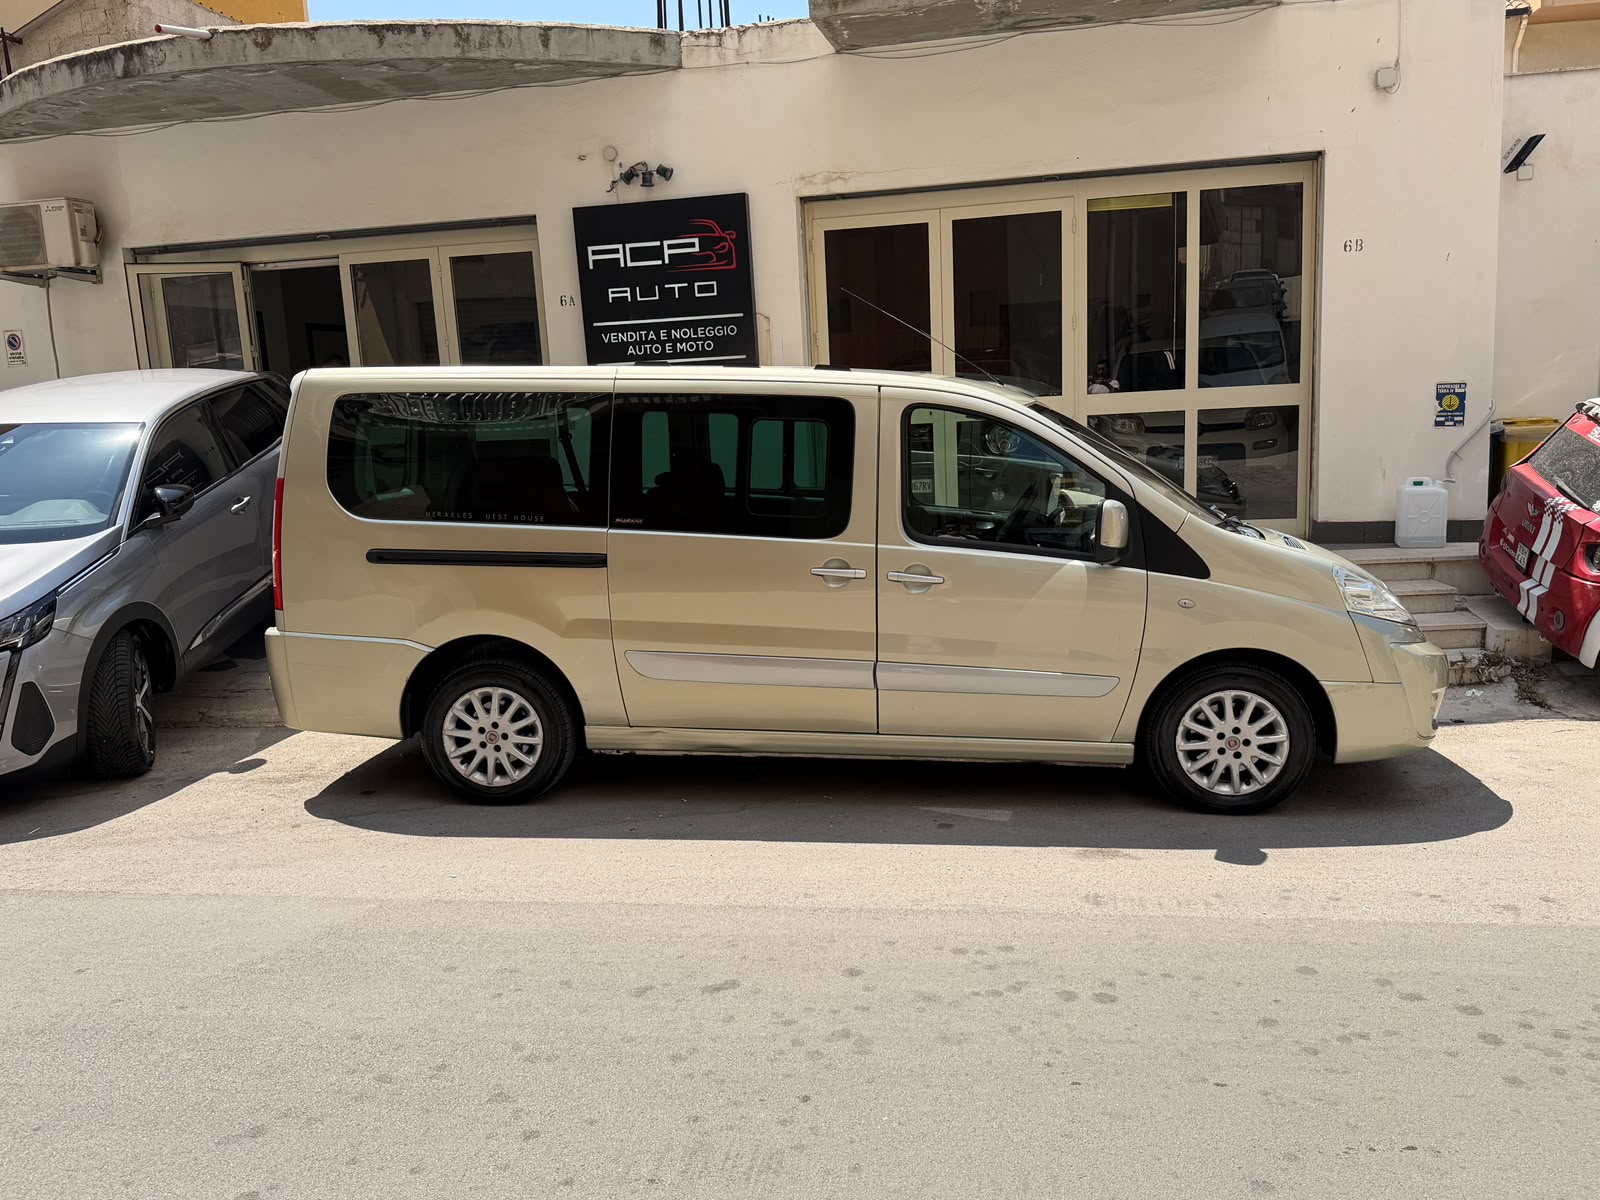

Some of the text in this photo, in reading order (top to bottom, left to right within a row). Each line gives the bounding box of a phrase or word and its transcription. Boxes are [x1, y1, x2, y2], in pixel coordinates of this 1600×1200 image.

[1343, 238, 1364, 252] 6B
[587, 238, 700, 270] ACP
[608, 281, 718, 303] AUTO
[559, 294, 576, 307] 6A
[601, 325, 737, 344] VENDITA E NOLEGGIO
[627, 340, 714, 356] AUTO E MOTO
[513, 514, 545, 522] HOUSE
